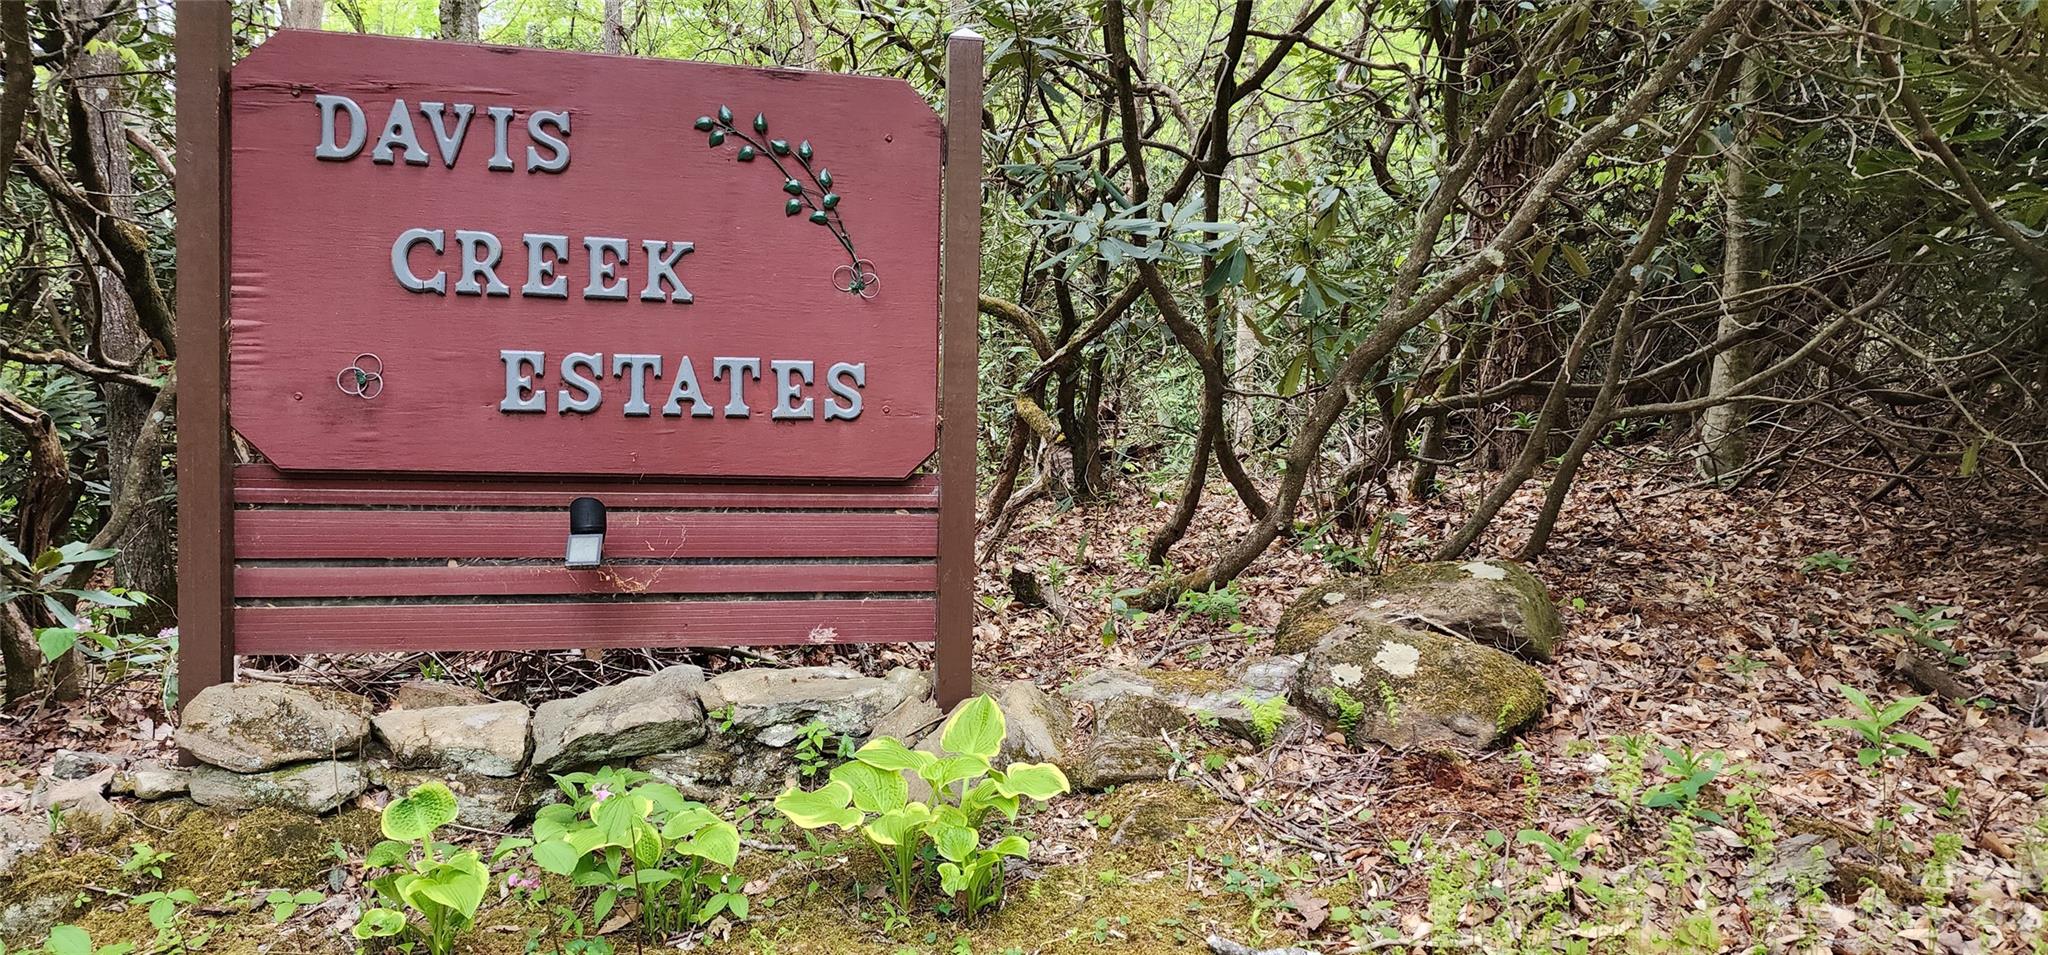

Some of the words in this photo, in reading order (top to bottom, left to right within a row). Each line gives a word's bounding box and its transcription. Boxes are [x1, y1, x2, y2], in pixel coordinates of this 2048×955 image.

[315, 94, 571, 173] DAVIS
[391, 228, 695, 304] CREEK
[500, 349, 866, 421] ESTATES
